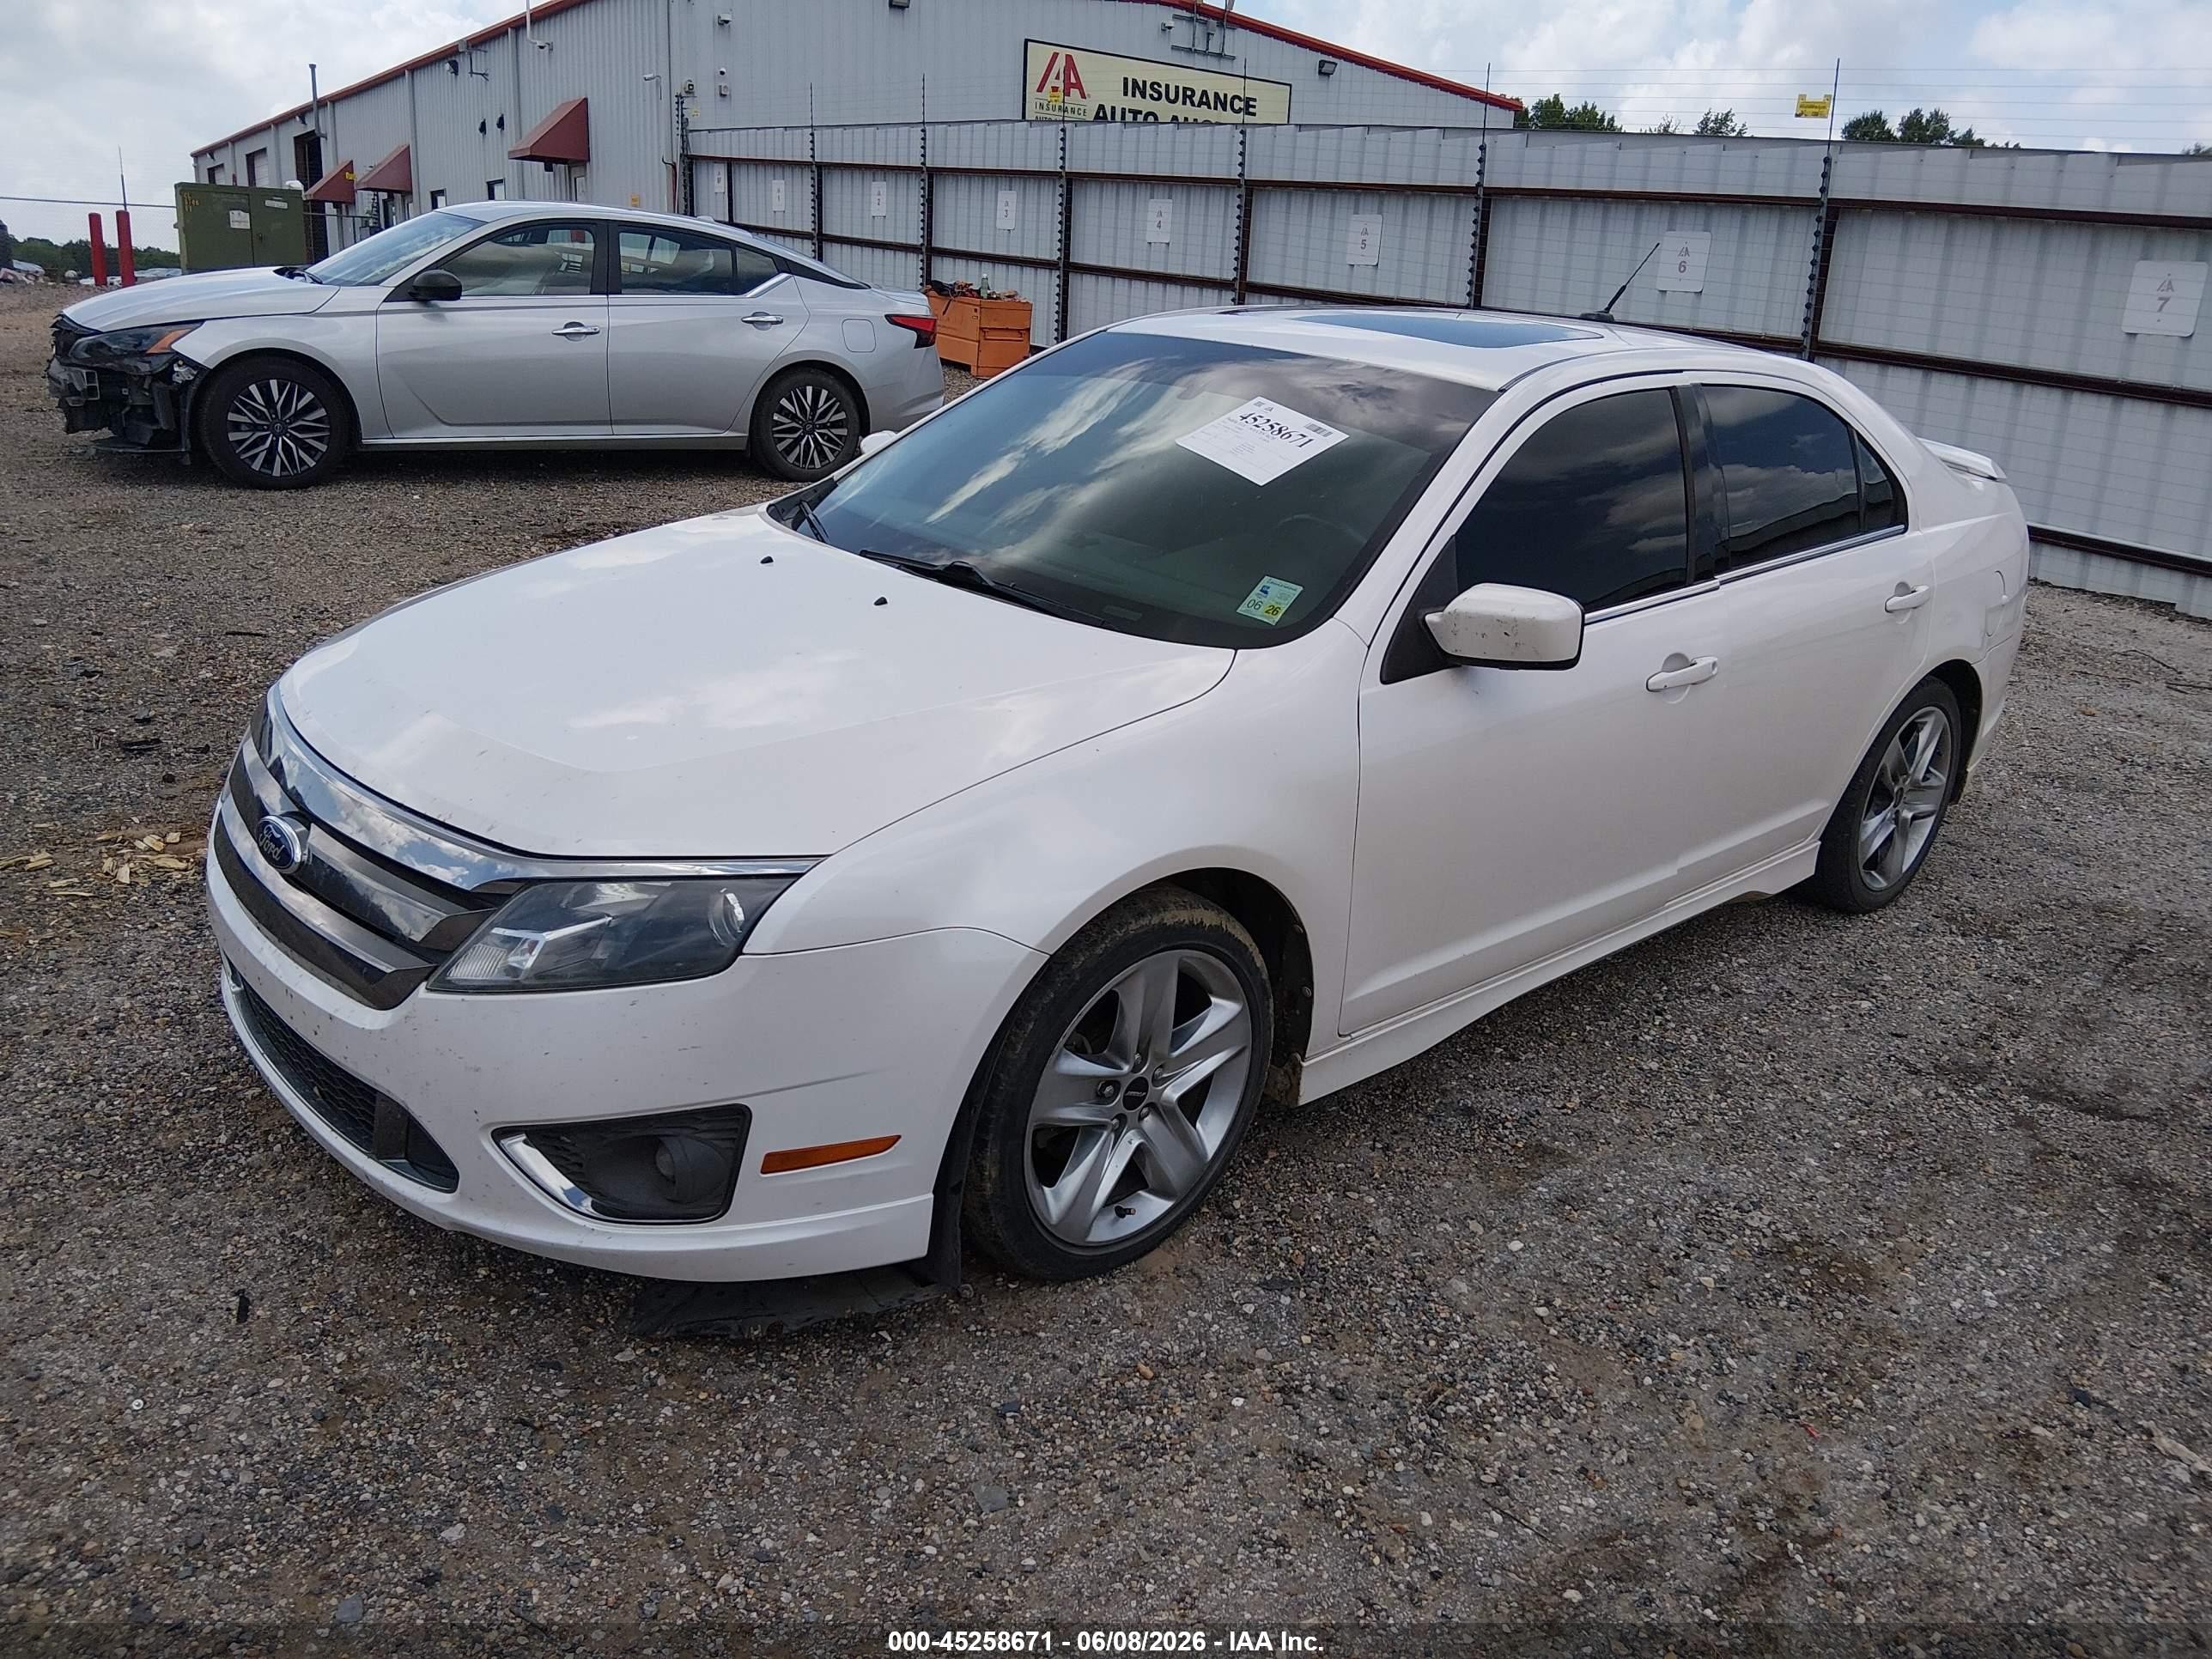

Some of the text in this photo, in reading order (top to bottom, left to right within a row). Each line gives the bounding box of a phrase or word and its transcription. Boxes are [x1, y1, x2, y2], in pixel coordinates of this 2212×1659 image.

[1122, 76, 1258, 117] INSURANCE
[1034, 101, 1088, 117] INSURANCE
[1156, 220, 1162, 230] 4
[1360, 239, 1367, 250] 5
[1678, 260, 1687, 274] 6
[2156, 296, 2172, 313] 7
[1239, 412, 1315, 447] 45258671
[1246, 599, 1281, 617] 06 26
[258, 823, 286, 861] Ford
